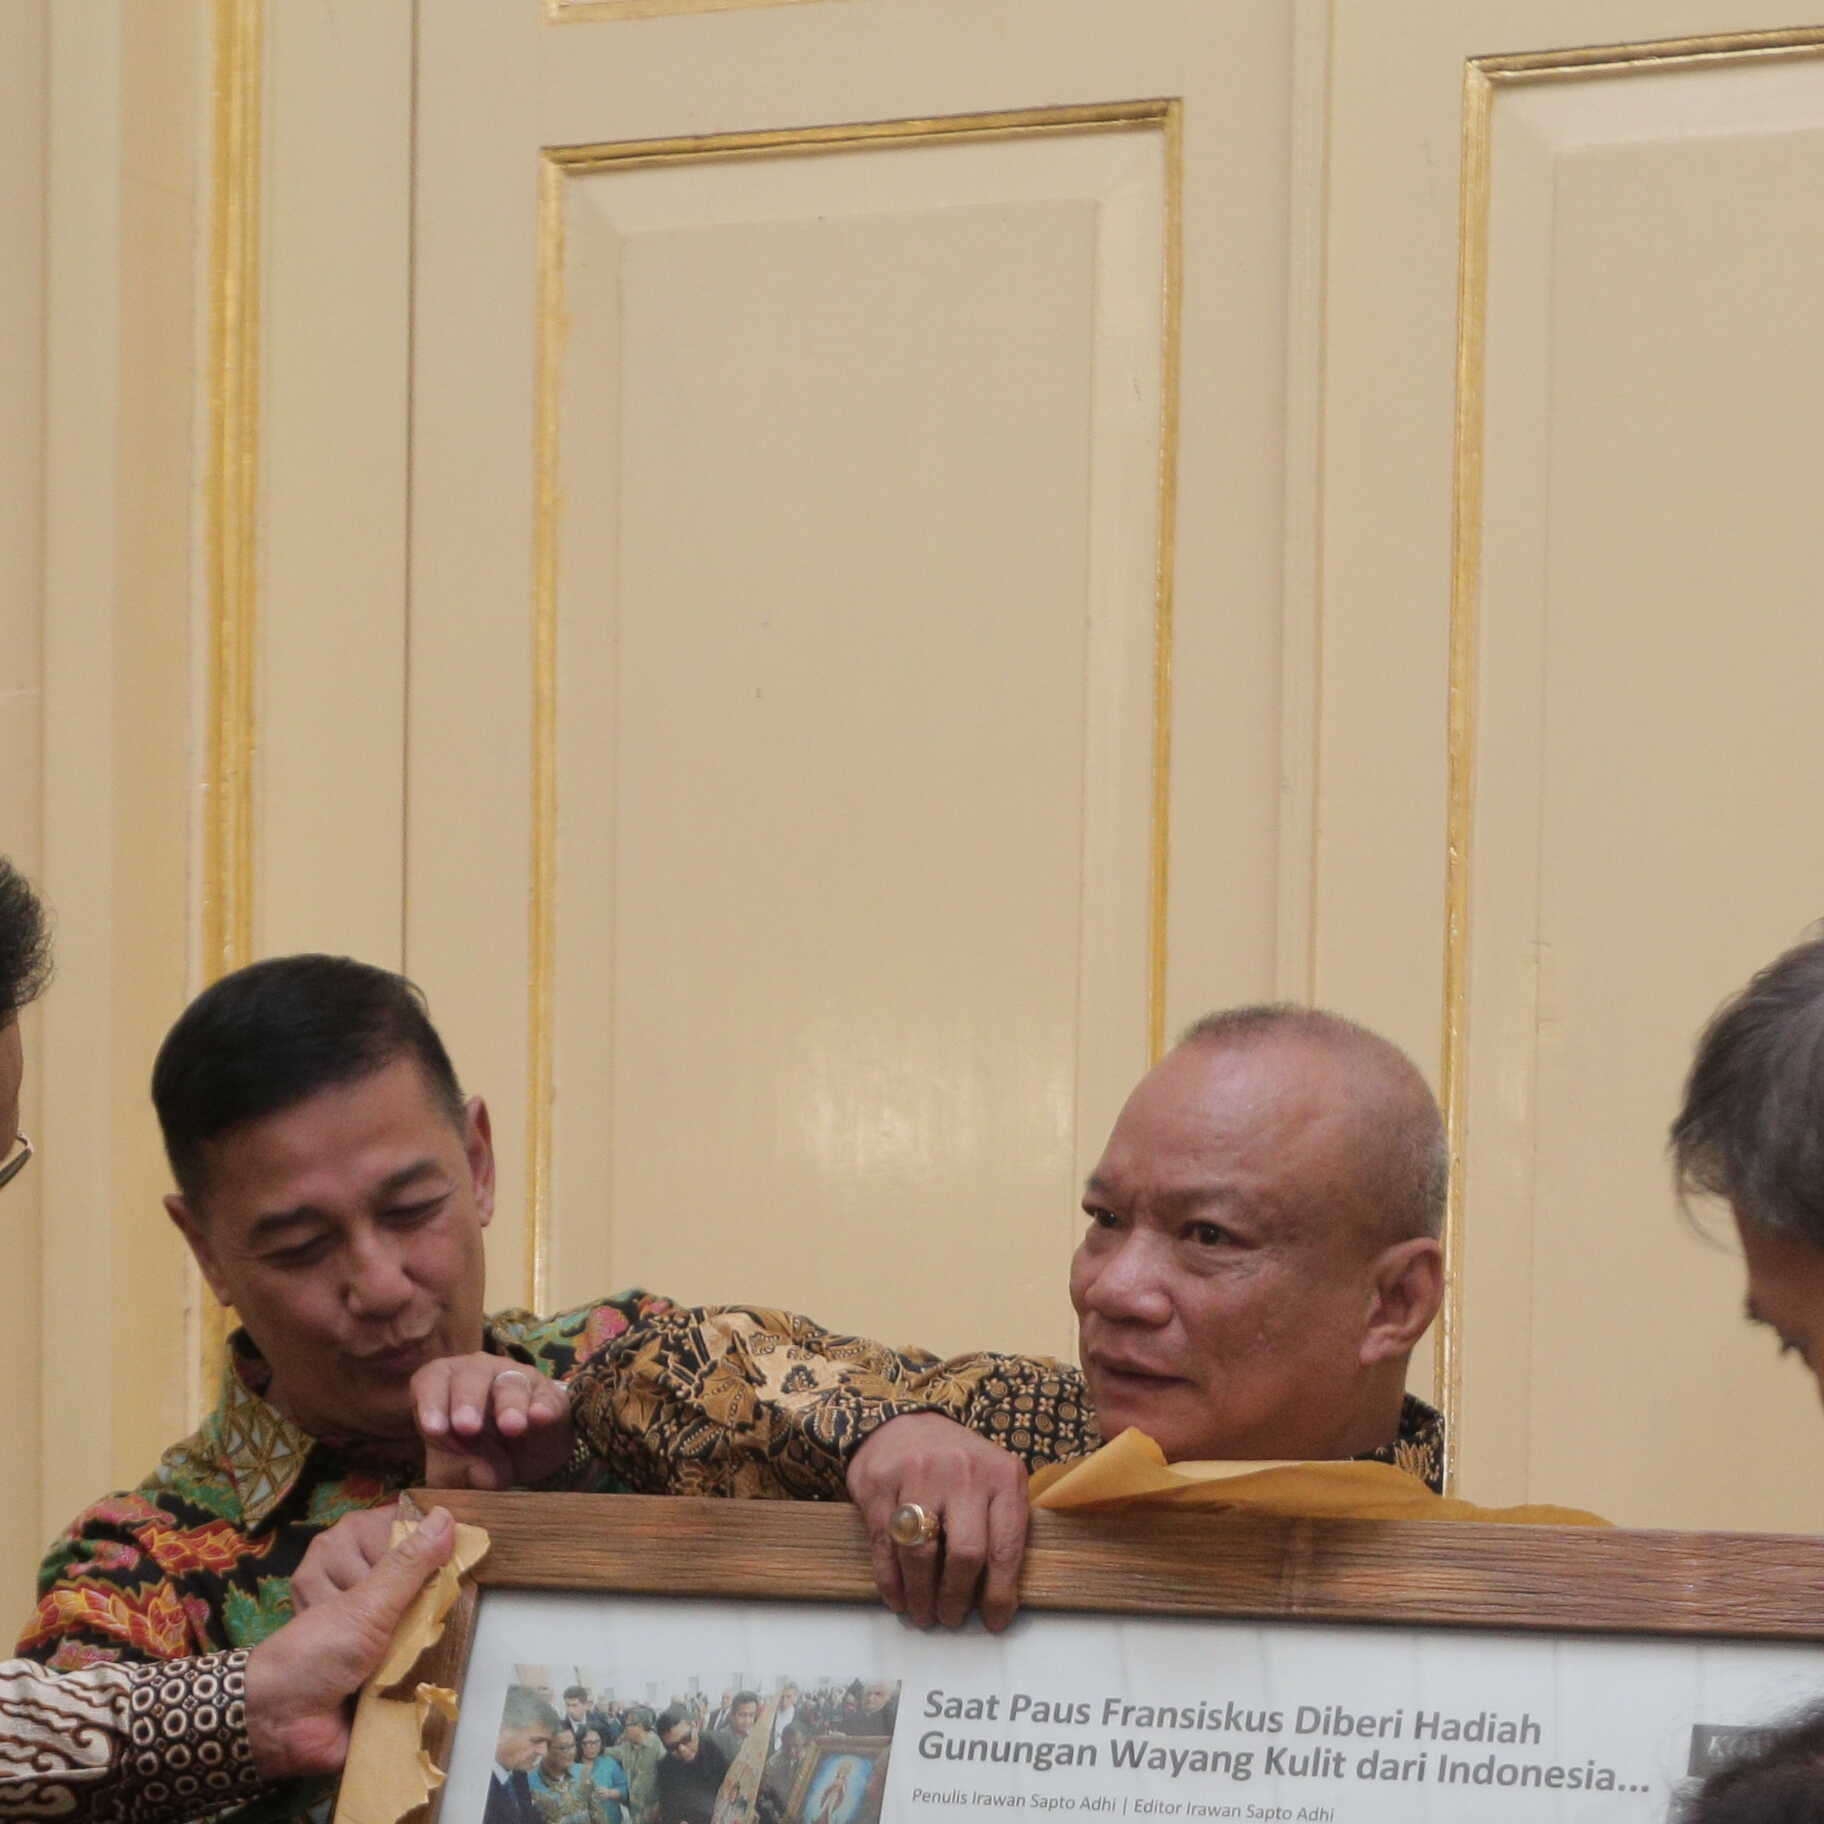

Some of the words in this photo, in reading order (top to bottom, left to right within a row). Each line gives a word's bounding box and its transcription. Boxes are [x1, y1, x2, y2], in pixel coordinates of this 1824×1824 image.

[923, 1689, 1001, 1721] Saat
[1008, 1693, 1092, 1726] Paus
[1101, 1697, 1284, 1734] Fransiskus
[1294, 1705, 1404, 1739] Diberi
[1413, 1710, 1542, 1745] Hadiah
[918, 1730, 1098, 1772] Gunungan
[1110, 1738, 1255, 1782] Wayang
[1263, 1745, 1347, 1779] Kulit
[1356, 1749, 1428, 1783] dari
[1437, 1754, 1650, 1793] Indonesia...
[911, 1788, 968, 1806] Penulis
[971, 1790, 1026, 1808] Irawan
[1029, 1793, 1076, 1813] Sapto
[1079, 1795, 1117, 1812] Adhi
[1133, 1798, 1183, 1815] Editor
[1186, 1801, 1242, 1818] Irawan
[1245, 1803, 1293, 1823] Sapto
[1296, 1806, 1335, 1823] Adhi
